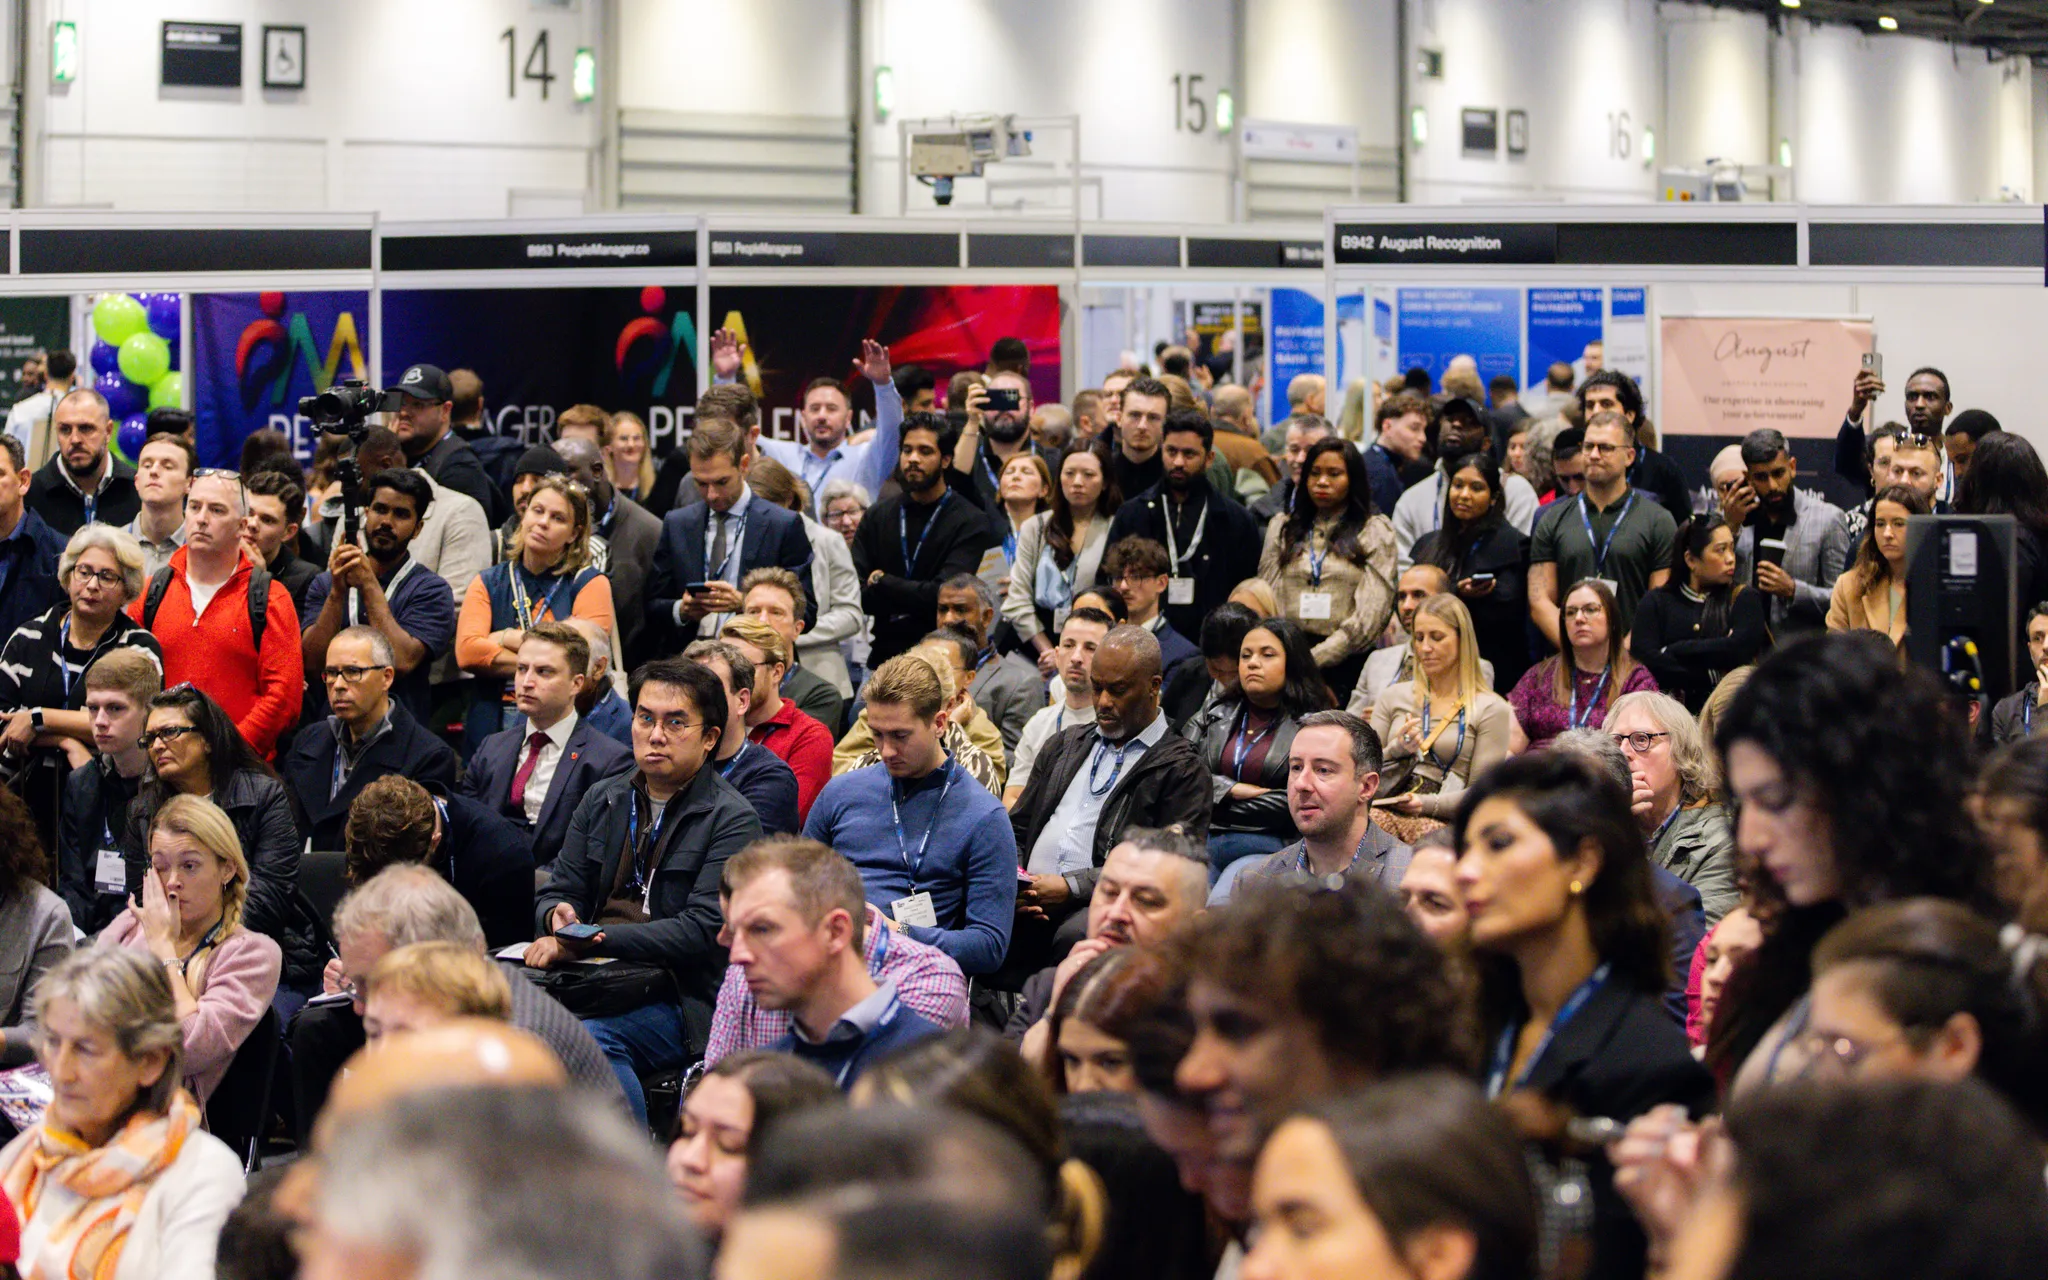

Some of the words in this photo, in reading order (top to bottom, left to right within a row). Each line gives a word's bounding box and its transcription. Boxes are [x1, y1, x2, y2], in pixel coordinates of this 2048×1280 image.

[501, 27, 556, 100] 14
[1172, 75, 1207, 134] 15
[1607, 110, 1631, 160] 16
[557, 242, 650, 259] PeopleManager.co
[1341, 235, 1375, 249] B942
[1379, 235, 1425, 252] August
[1426, 235, 1502, 253] Recognition
[1713, 331, 1812, 375] August
[1703, 396, 1721, 406] Our
[1723, 396, 1763, 408] expertise
[1774, 396, 1825, 409] showcasing
